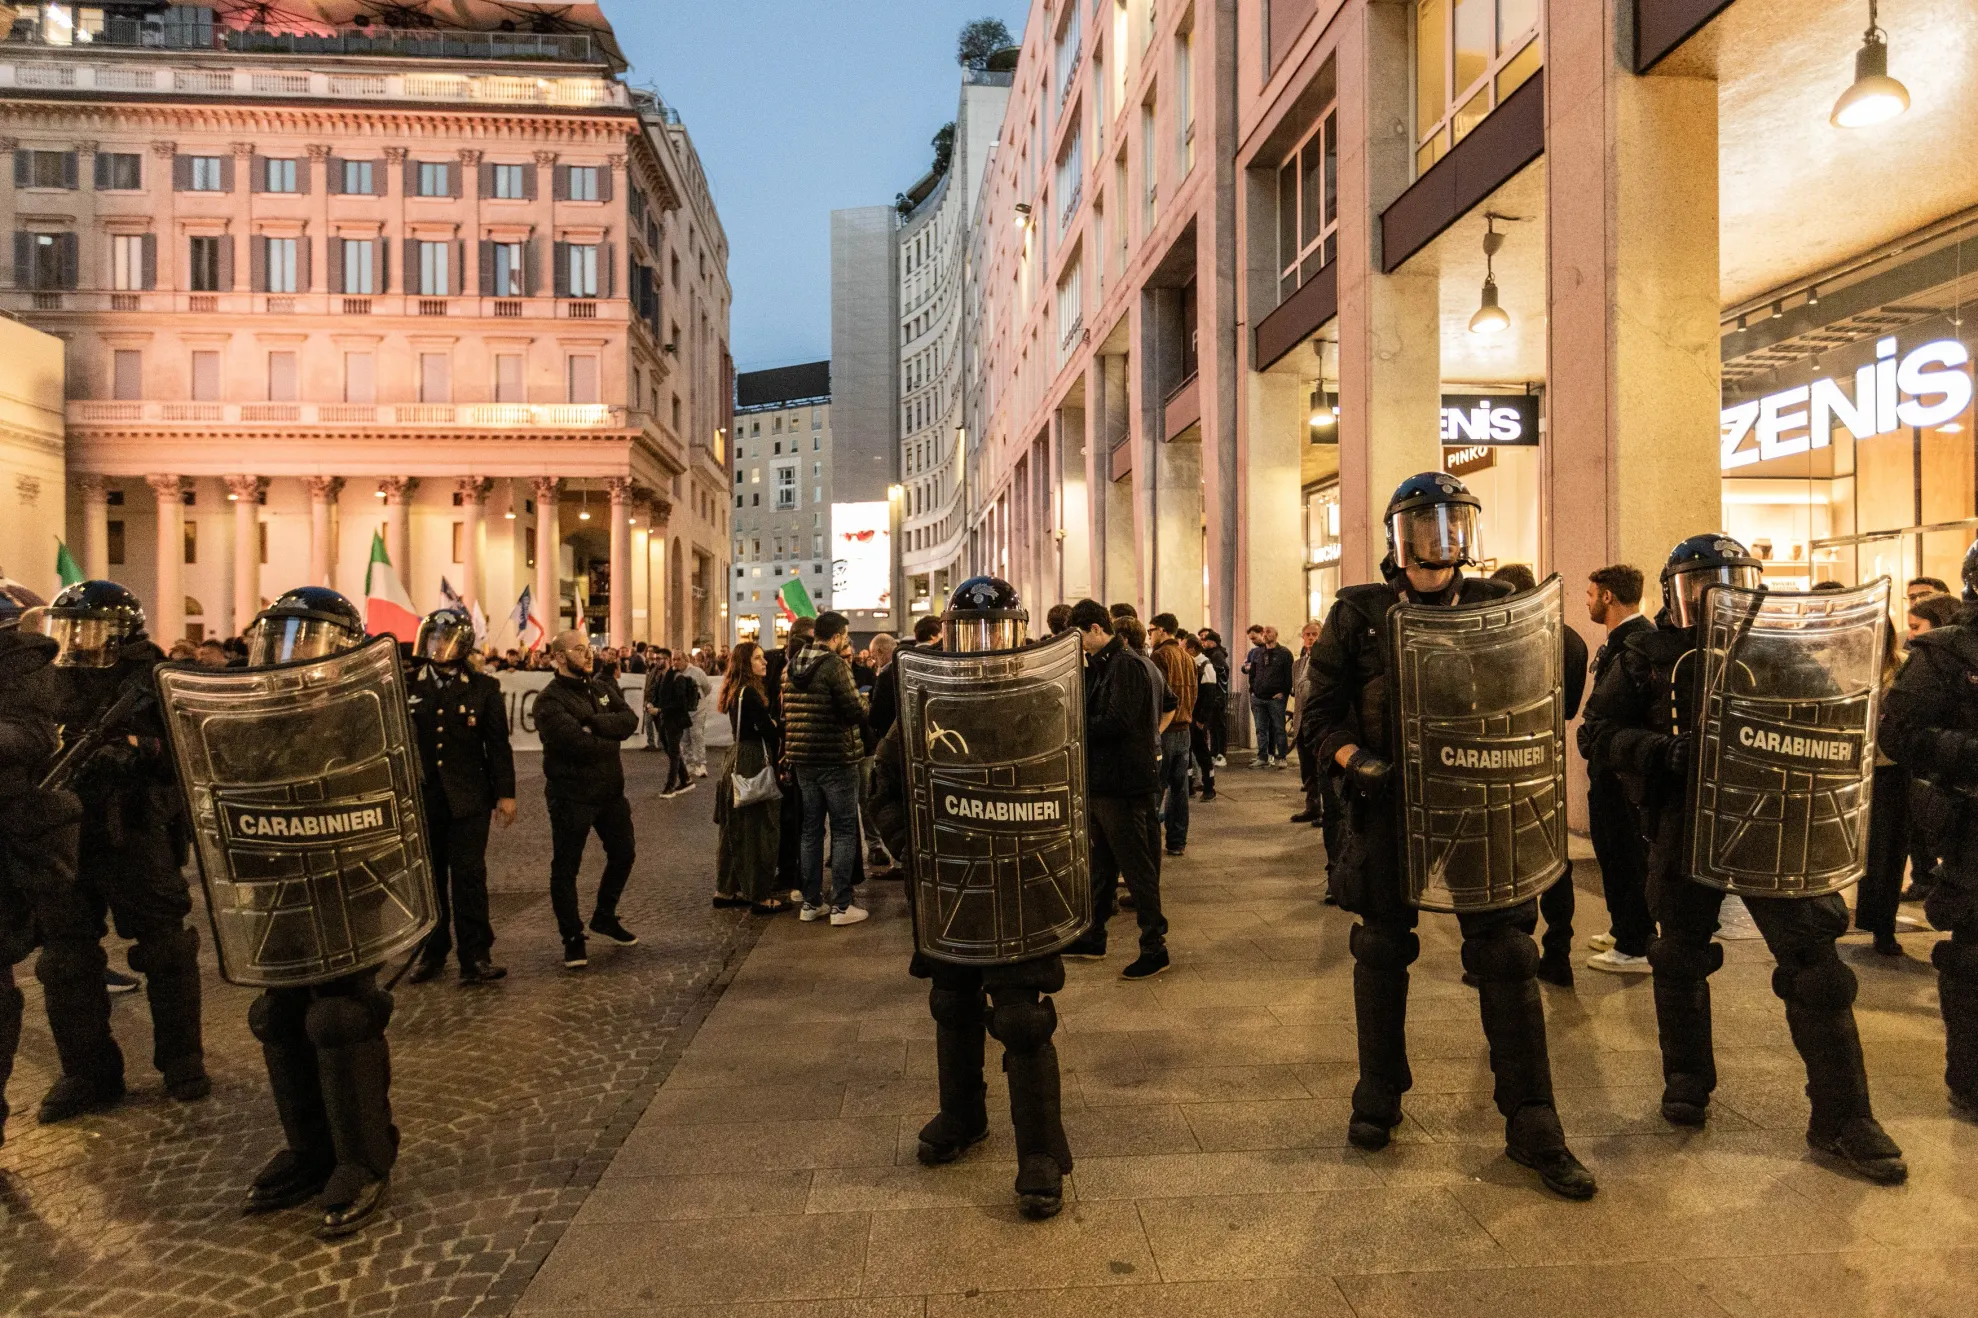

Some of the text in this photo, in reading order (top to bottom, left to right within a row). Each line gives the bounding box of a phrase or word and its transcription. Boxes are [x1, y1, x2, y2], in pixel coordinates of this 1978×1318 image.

[1447, 446, 1488, 468] PINKO
[1740, 726, 1853, 760] CARABINIERI
[1440, 745, 1545, 769] CARABINIERI
[945, 794, 1060, 821] CARABINIERI
[239, 807, 383, 836] CARABINIERI
